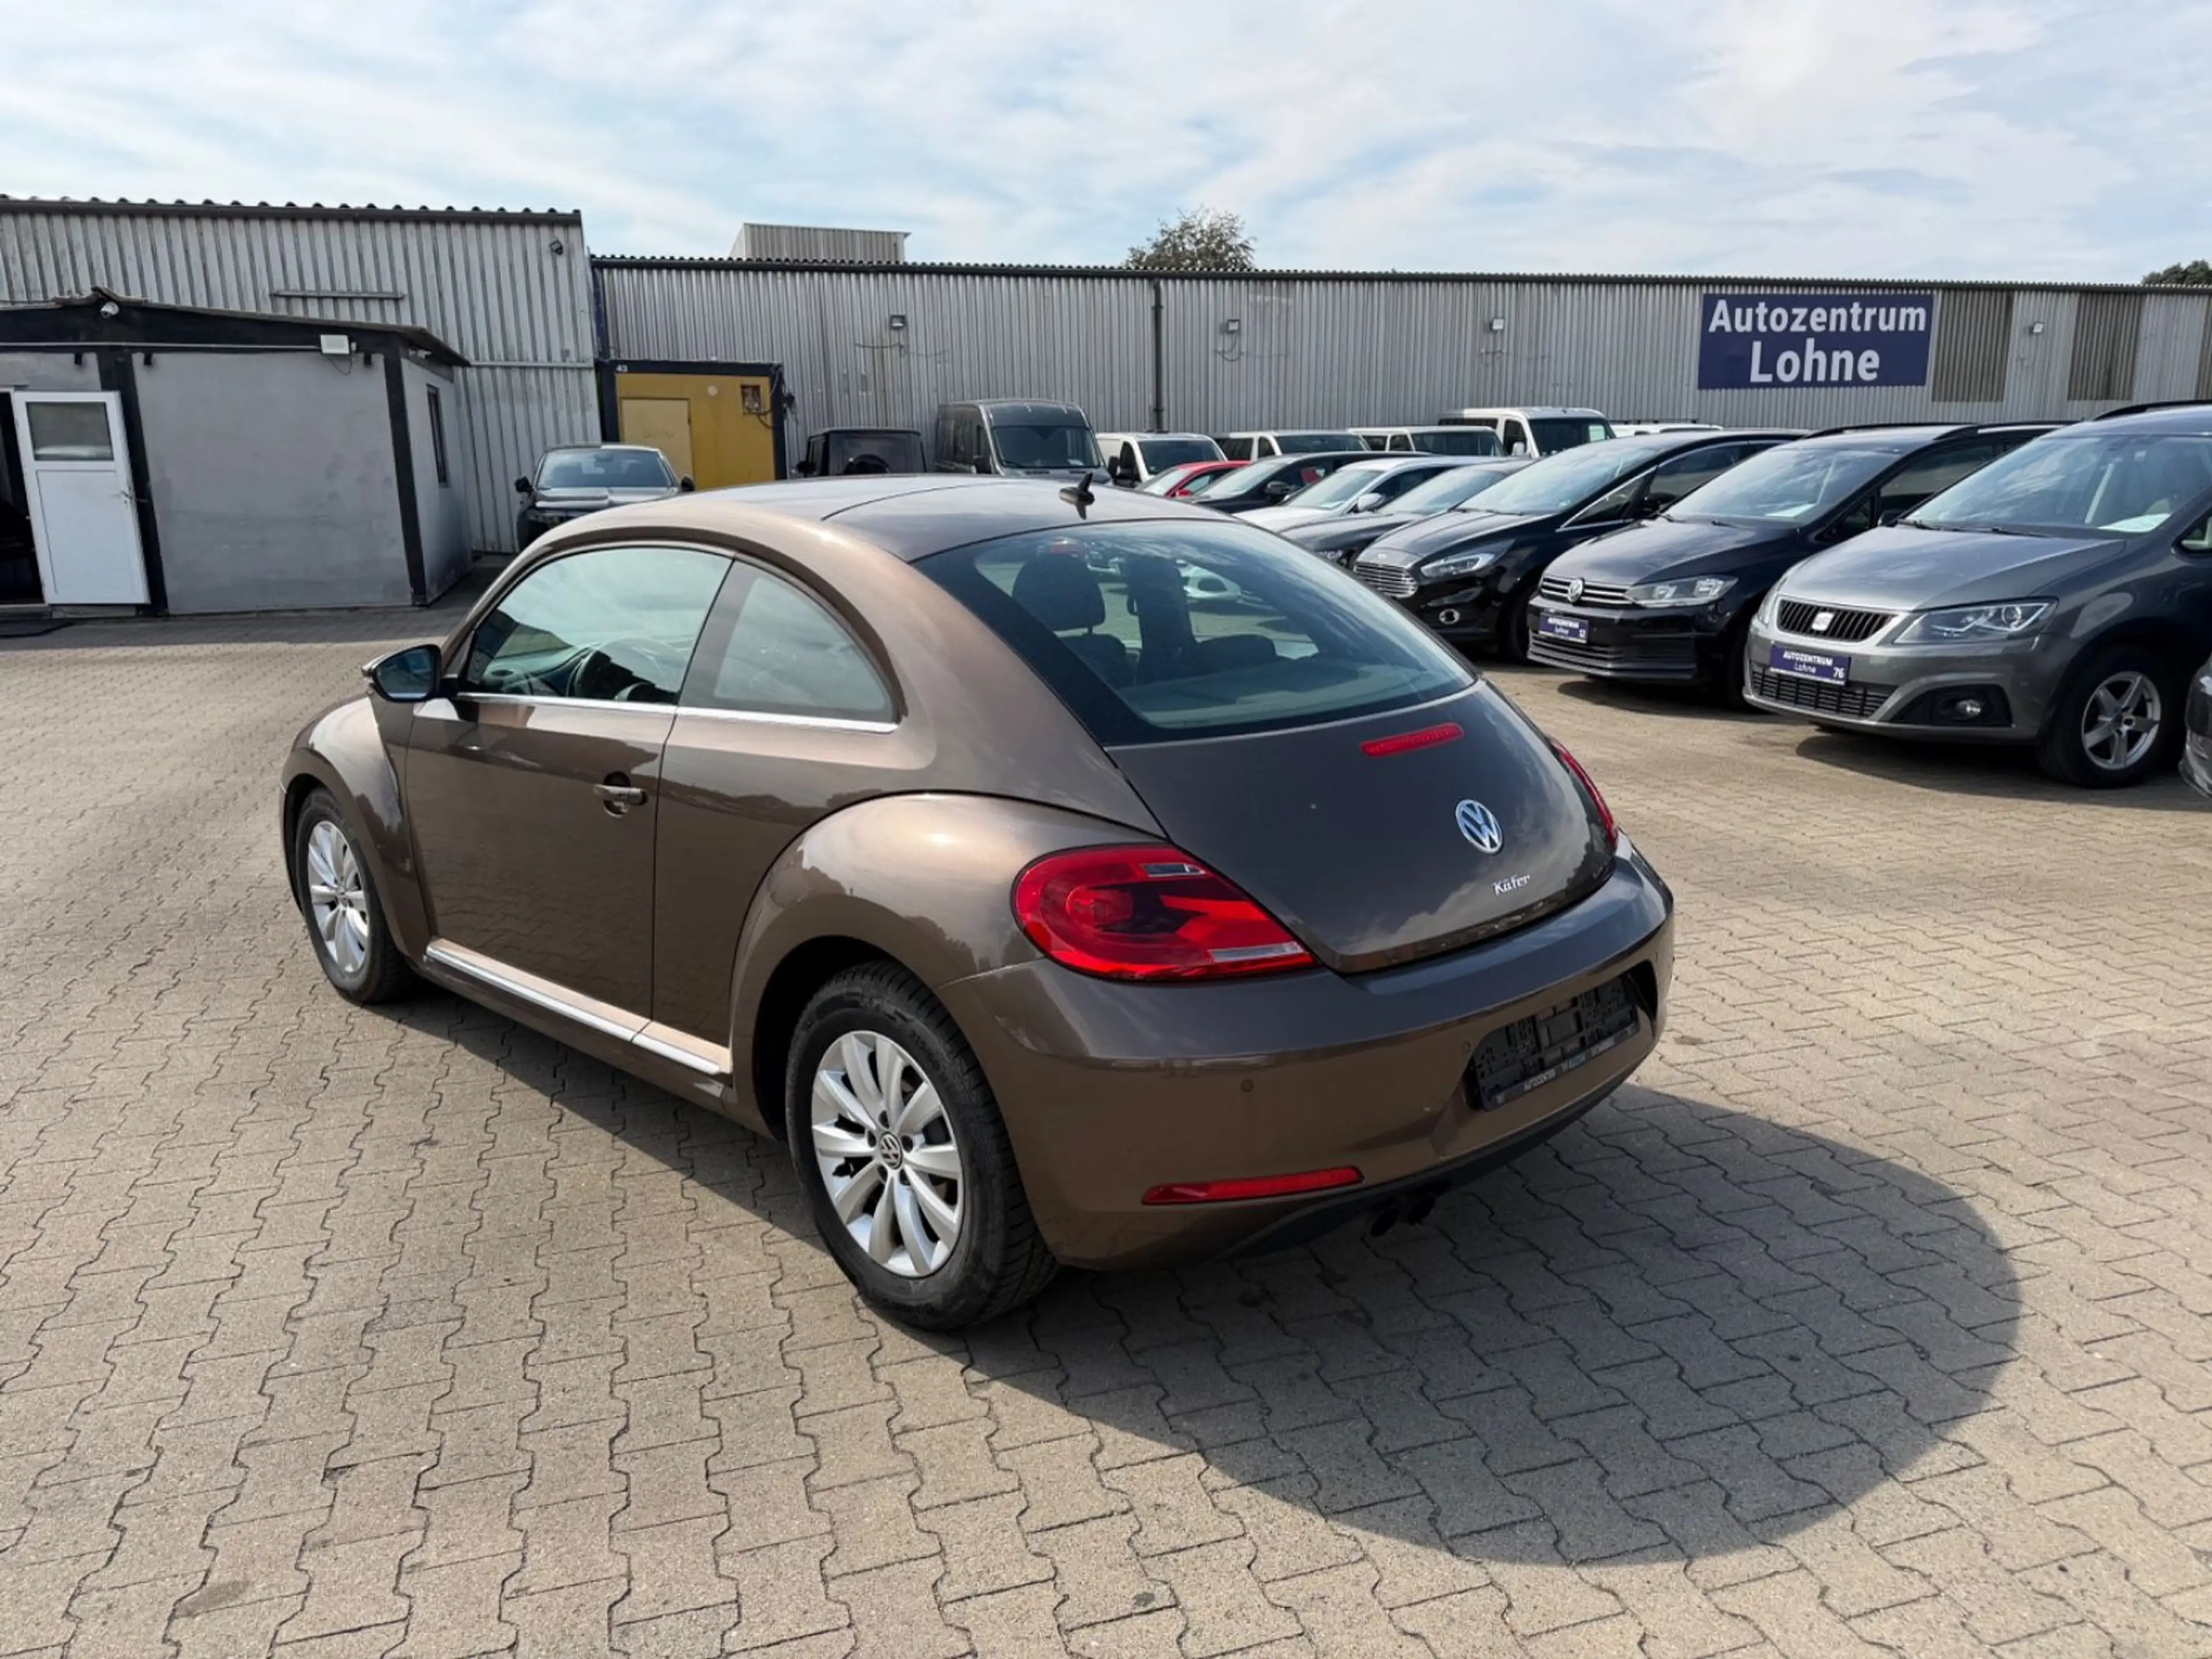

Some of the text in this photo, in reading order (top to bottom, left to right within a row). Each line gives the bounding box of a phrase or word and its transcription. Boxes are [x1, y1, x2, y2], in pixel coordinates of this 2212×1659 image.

[1709, 299, 1926, 332] Autozentrum
[1750, 338, 1880, 382] Lohne
[1783, 650, 1833, 666] AUTOZENTRUM
[1833, 666, 1844, 679] 76
[1492, 874, 1530, 896] Käfer
